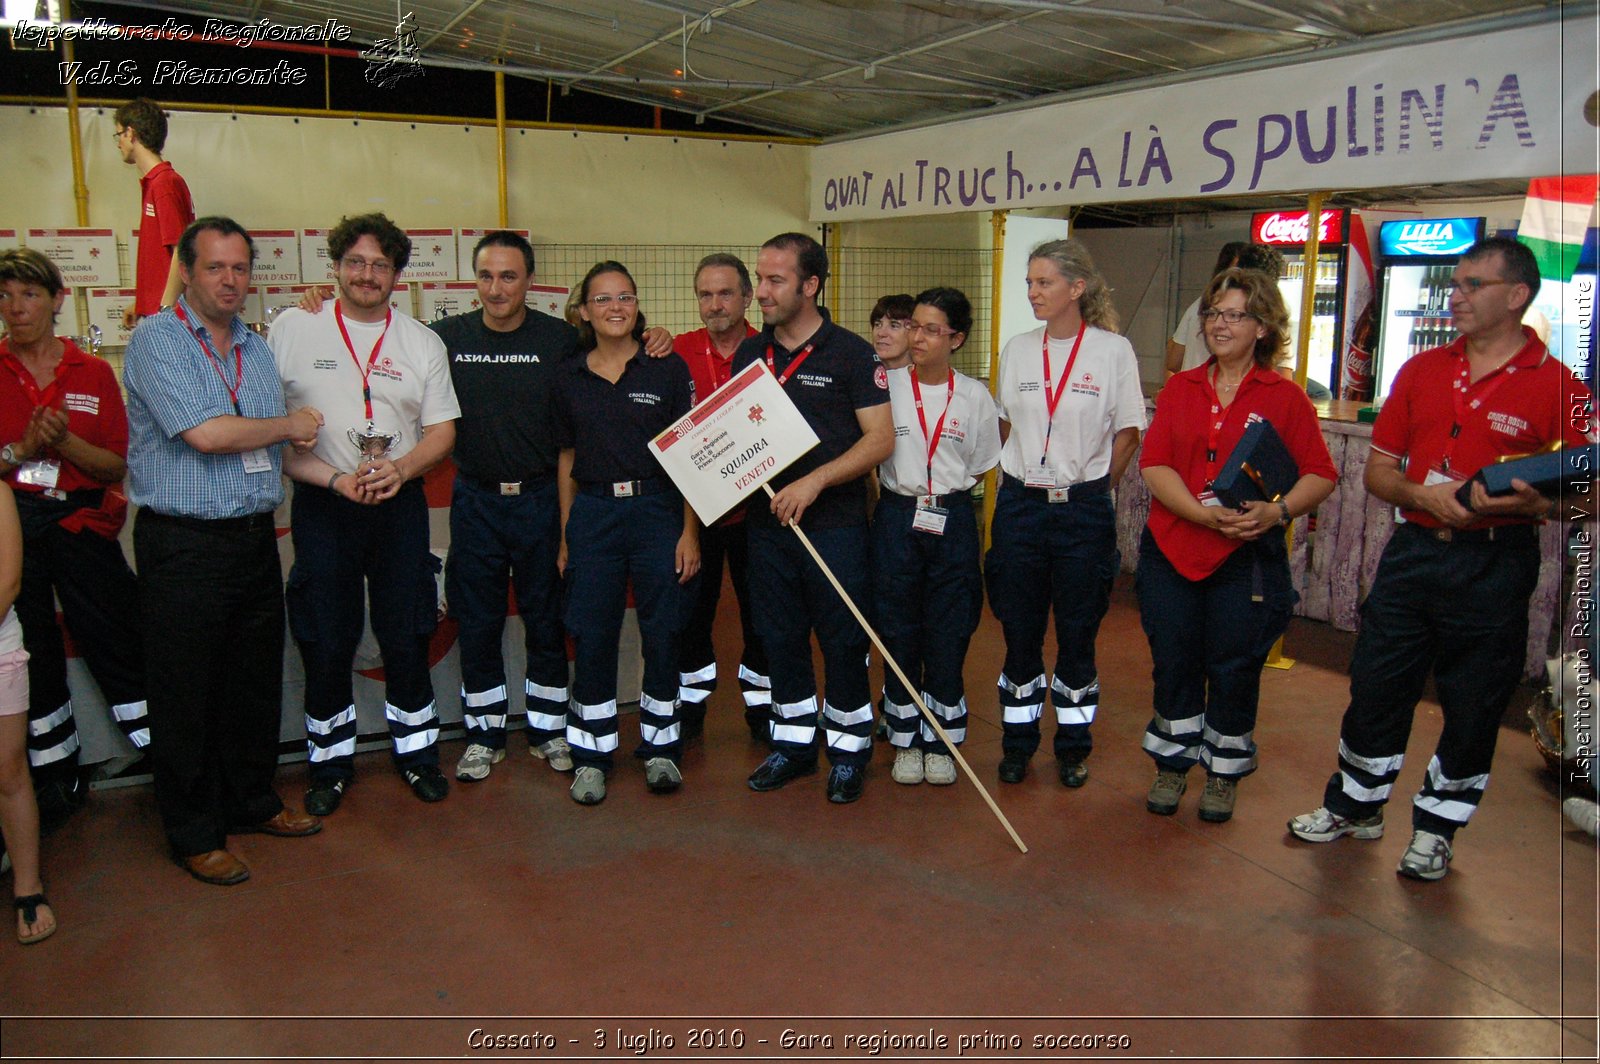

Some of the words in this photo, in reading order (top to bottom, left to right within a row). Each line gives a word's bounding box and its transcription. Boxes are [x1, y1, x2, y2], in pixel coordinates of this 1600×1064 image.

[824, 170, 873, 211] QUAT
[881, 172, 907, 209] AL
[1399, 223, 1454, 241] LILIA
[407, 261, 435, 269] QUADRA
[270, 273, 298, 281] D'ASTI
[801, 380, 825, 388] ITALIANA
[815, 375, 833, 383] ROSSA
[633, 397, 656, 405] ITALIANA
[645, 393, 661, 401] ROSSA
[1487, 411, 1508, 424] CROCE
[1507, 415, 1528, 431] ROSSA
[1490, 421, 1519, 437] ITALIANA
[691, 450, 704, 461] Gara
[703, 431, 728, 452] Regionale
[694, 454, 709, 466] C.R.I.
[697, 457, 713, 471] Primo
[712, 440, 736, 460] Soccorso
[720, 437, 769, 479] SQUADRA
[735, 455, 775, 491] VENETO
